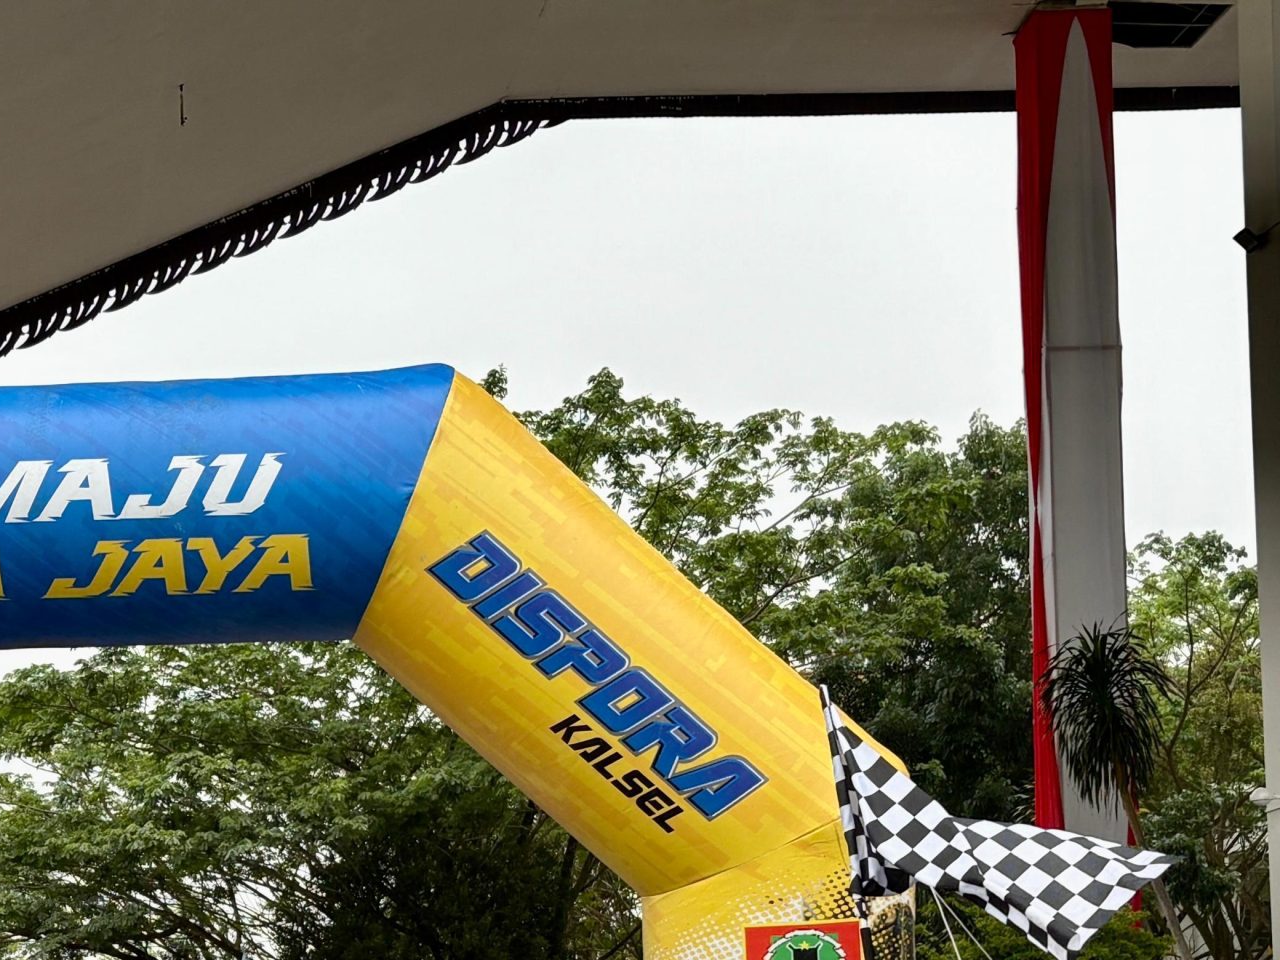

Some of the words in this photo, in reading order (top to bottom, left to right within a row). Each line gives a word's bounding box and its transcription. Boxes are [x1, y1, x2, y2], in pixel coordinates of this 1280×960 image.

[42, 533, 319, 598] JAYA
[424, 529, 769, 821] DISPORA
[549, 714, 684, 833] KALSEL
